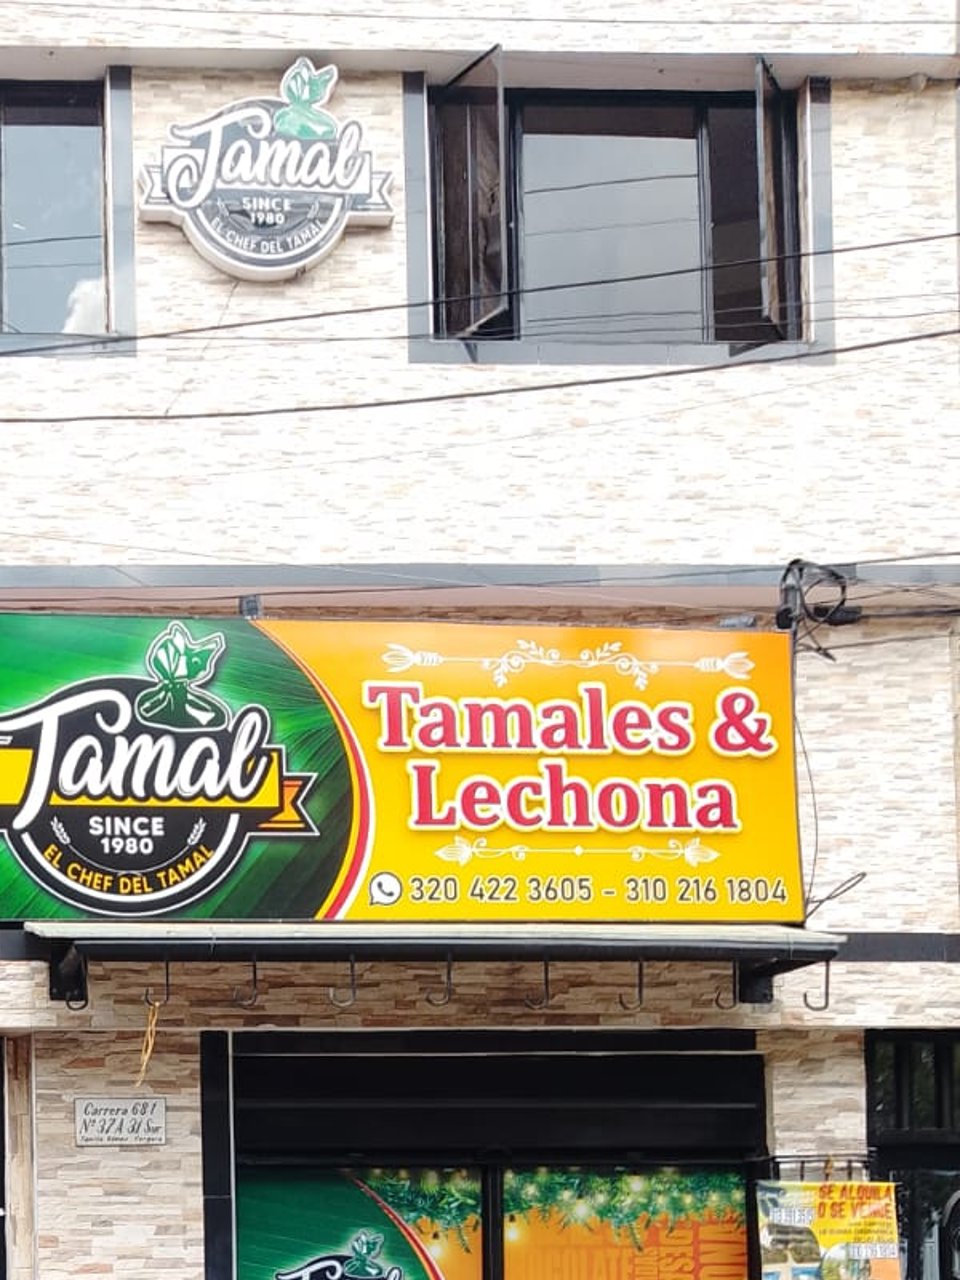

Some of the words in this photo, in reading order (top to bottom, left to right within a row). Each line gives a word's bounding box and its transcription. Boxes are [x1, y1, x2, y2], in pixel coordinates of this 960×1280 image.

[170, 107, 363, 207] Tamal
[242, 197, 292, 212] SINCE
[250, 211, 285, 224] 1980
[211, 216, 225, 233] EL
[225, 230, 257, 251] CHEF
[260, 240, 284, 254] DEL
[286, 219, 324, 250] TAMAL
[366, 684, 693, 752] Tamales
[712, 690, 774, 754] &
[409, 762, 739, 829] Lechona
[88, 815, 166, 837] SINCE
[99, 837, 155, 856] 1980
[42, 843, 63, 870] EL
[66, 862, 114, 893] CHEF
[118, 875, 153, 895] DEL
[156, 844, 215, 889] TAMAL
[410, 877, 458, 902] 320
[470, 877, 517, 902] 422
[527, 877, 592, 902] 3605
[625, 878, 667, 903] 310
[678, 878, 717, 903] 216
[726, 878, 788, 904] 1804
[83, 1101, 129, 1117] Carrera
[144, 1118, 162, 1134] Sur
[818, 1184, 835, 1201] SE
[817, 1202, 826, 1219] O
[829, 1202, 846, 1219] SE
